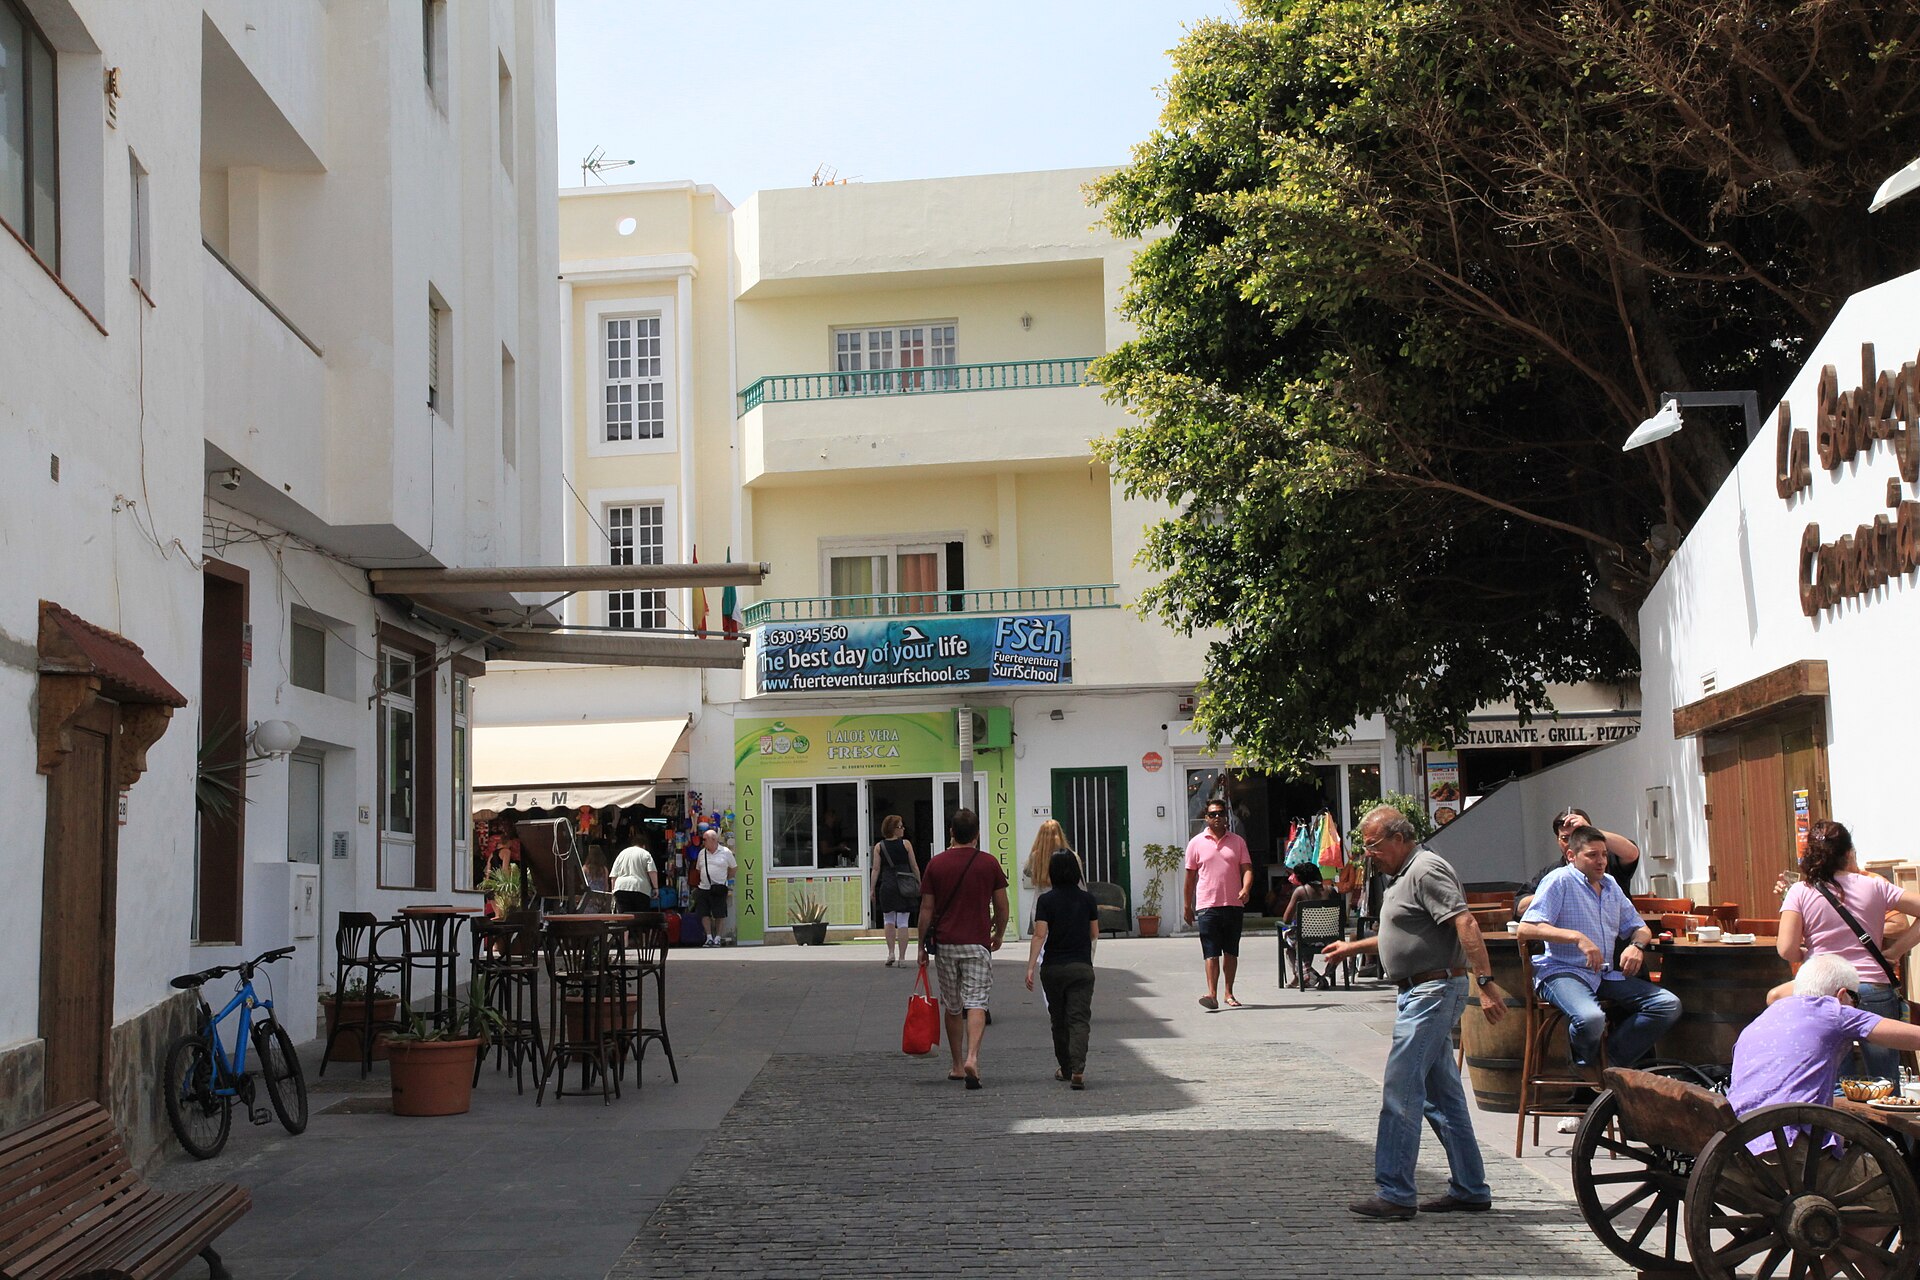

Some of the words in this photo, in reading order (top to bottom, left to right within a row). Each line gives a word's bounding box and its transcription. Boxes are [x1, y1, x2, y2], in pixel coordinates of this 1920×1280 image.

[1776, 400, 1812, 499] La
[1817, 342, 1920, 482] Bodeg
[770, 630, 795, 645] 630
[796, 628, 820, 643] 345
[823, 625, 847, 641] 560
[995, 617, 1062, 653] FSch
[760, 651, 784, 672] The
[788, 648, 829, 669] best
[833, 644, 867, 669] day
[871, 642, 889, 663] of
[892, 642, 935, 666] your
[938, 635, 968, 657] life
[993, 651, 1059, 667] Fuerteventura
[992, 662, 1058, 682] SurfSchool
[827, 730, 865, 743] L'ALOE
[868, 728, 900, 742] VERA
[1450, 728, 1539, 745] ESTAURANTE
[1548, 727, 1588, 742] GRILL
[827, 745, 901, 759] FRESCA
[506, 793, 518, 807] J
[530, 797, 538, 806] &
[551, 791, 568, 804] M
[743, 784, 755, 841] ALOE
[744, 859, 756, 916] VERA
